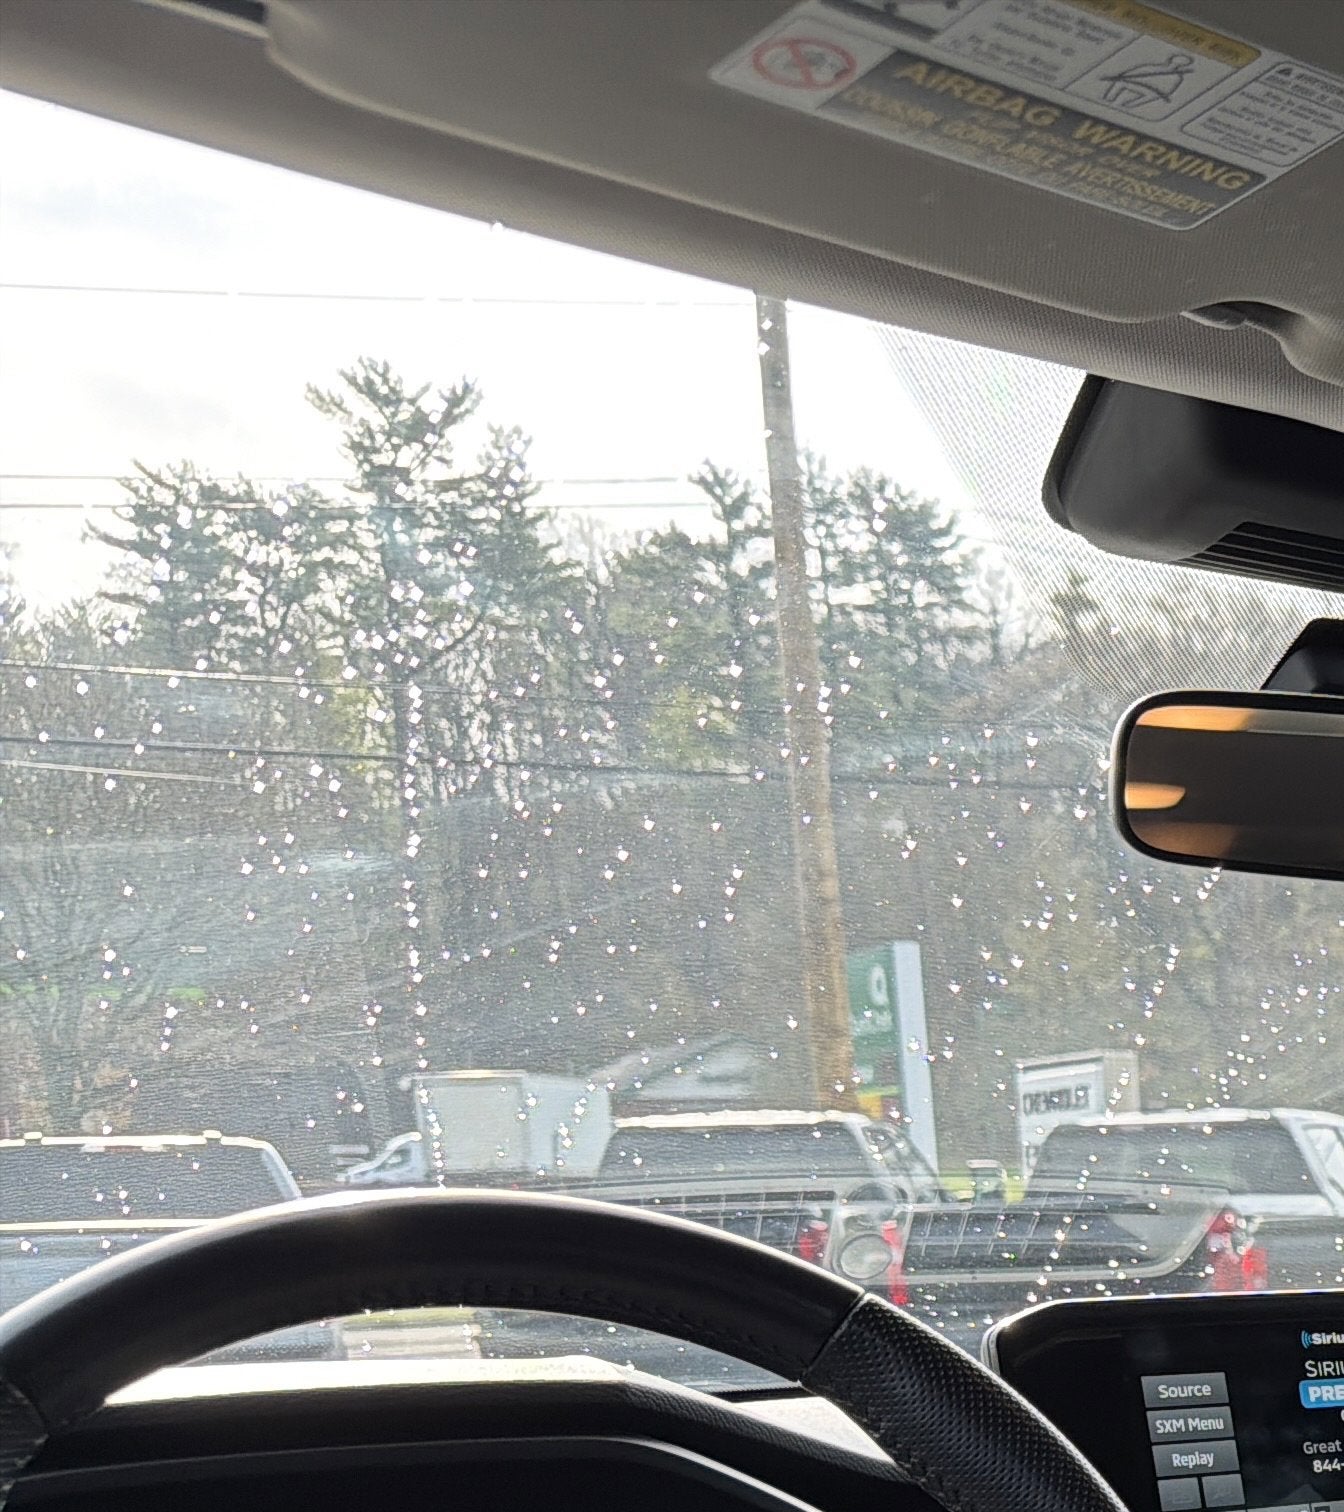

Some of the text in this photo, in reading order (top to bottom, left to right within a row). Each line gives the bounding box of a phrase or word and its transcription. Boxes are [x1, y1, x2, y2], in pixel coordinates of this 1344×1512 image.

[900, 60, 1057, 129] AIRBAG
[1072, 118, 1250, 192] WARNING
[1066, 160, 1218, 215] AVERTISSEMENT
[1157, 1383, 1212, 1399] Source
[1155, 1415, 1225, 1435] SXM Menu
[1303, 1439, 1342, 1455] Great
[1172, 1451, 1215, 1469] Replay
